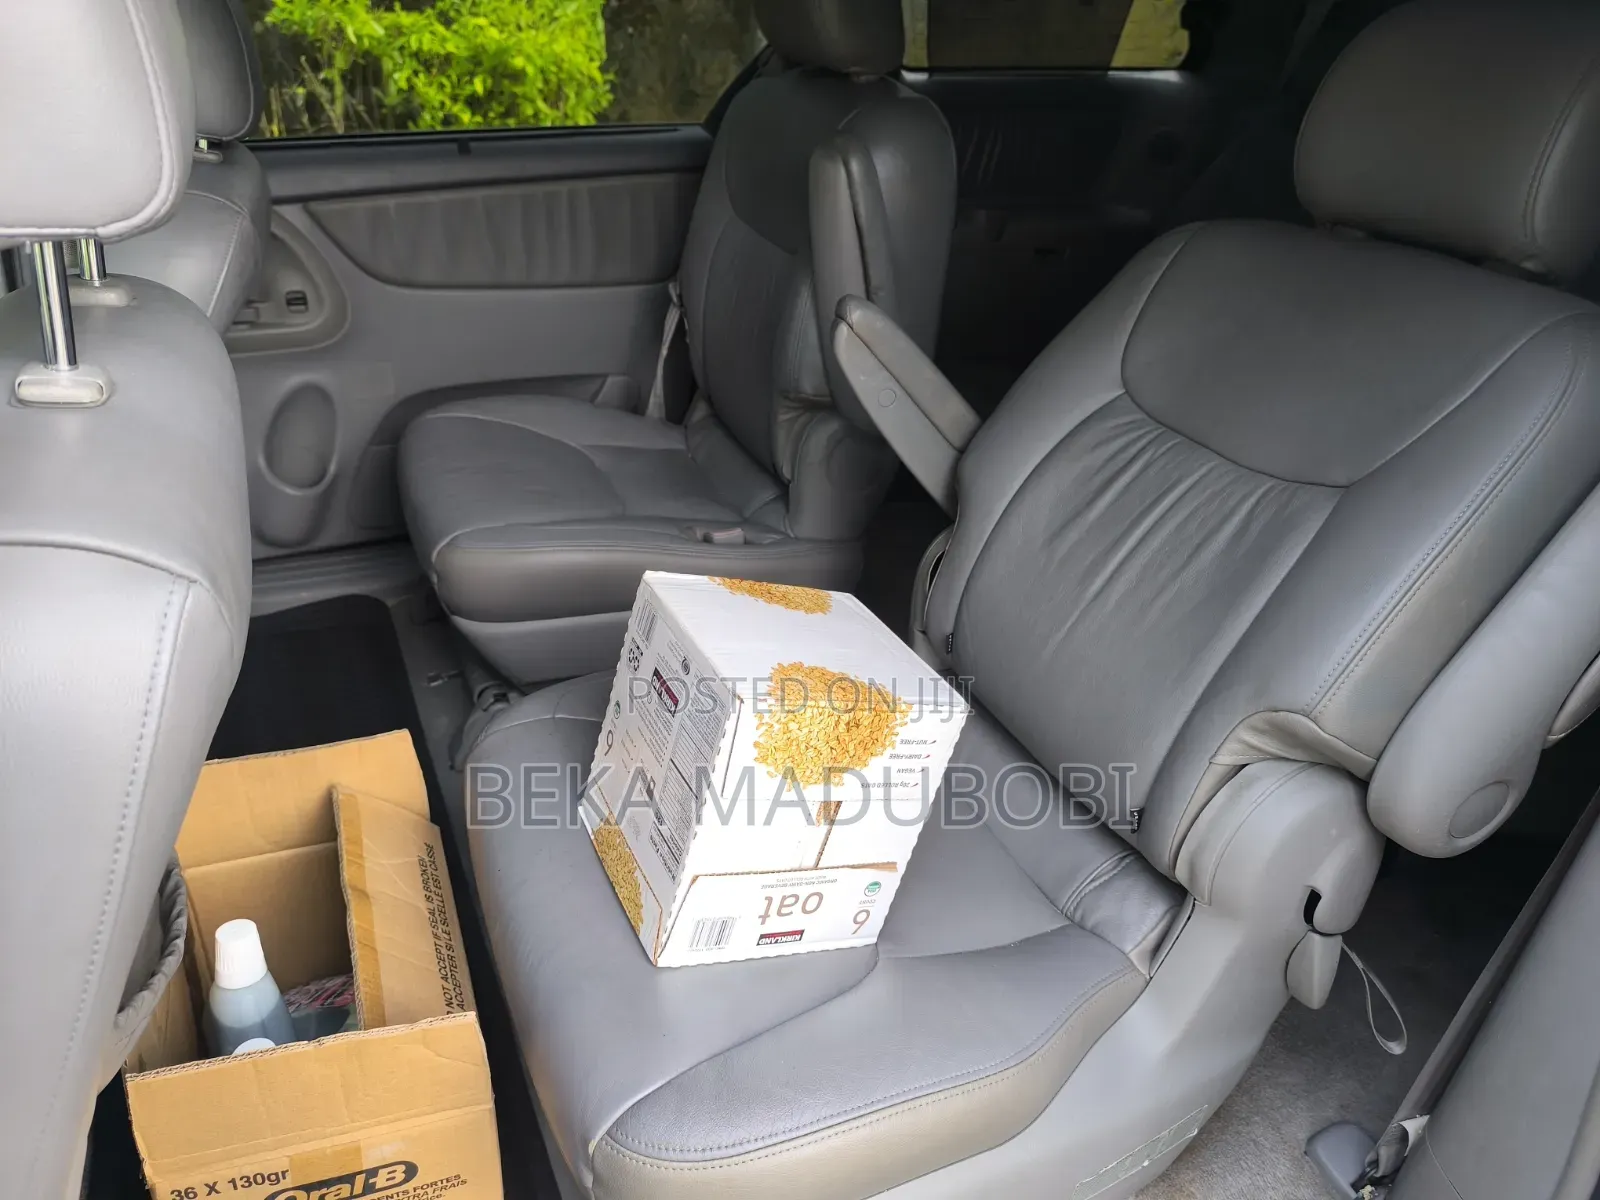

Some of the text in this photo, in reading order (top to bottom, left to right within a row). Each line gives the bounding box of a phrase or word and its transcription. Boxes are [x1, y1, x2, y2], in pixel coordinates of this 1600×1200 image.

[417, 853, 433, 893] BROKEN
[430, 871, 442, 890] EST
[424, 893, 435, 904] IS
[758, 891, 824, 925] oat
[427, 906, 439, 931] SEAL
[851, 909, 871, 935] 6
[432, 930, 442, 941] IF
[441, 928, 453, 942] LE
[759, 934, 801, 945] KIRKLAND
[444, 942, 455, 953] SI
[434, 941, 451, 984] ACCEPT
[447, 954, 467, 1012] ACCEPTER
[442, 984, 455, 1009] NOT
[170, 1168, 290, 1200] 36 X 130gr
[413, 1174, 462, 1193] FORTES
[432, 1179, 468, 1195] FRAIS
